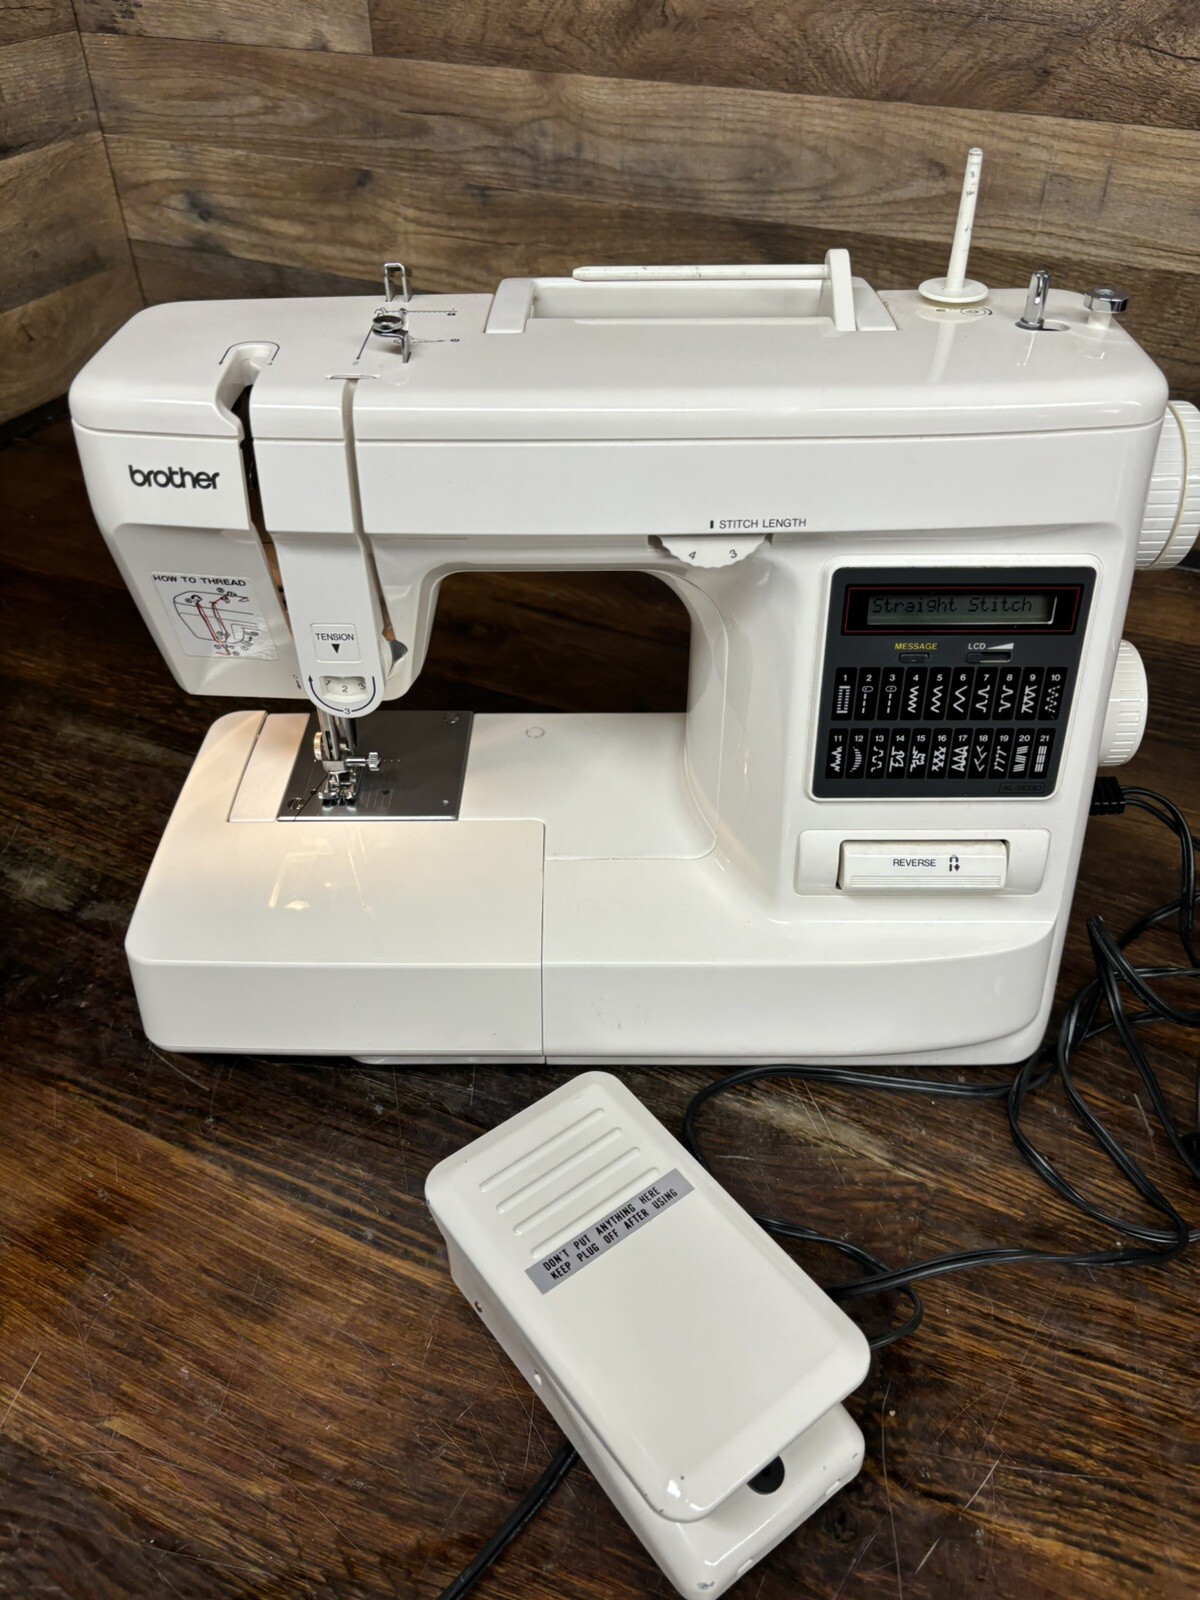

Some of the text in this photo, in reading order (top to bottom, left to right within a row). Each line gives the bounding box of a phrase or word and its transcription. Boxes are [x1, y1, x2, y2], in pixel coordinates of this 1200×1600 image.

[128, 465, 220, 489] brother
[719, 518, 807, 529] STITCH LENGTH
[688, 550, 738, 559] 4 3
[153, 574, 246, 587] HOW TO THREAD
[872, 596, 1032, 613] Straight Stitch
[315, 633, 354, 641] TENSION
[968, 642, 986, 650] LCD
[892, 858, 936, 867] REVERSE
[543, 1186, 661, 1271] DON'T PUT ANYTHING HERE
[550, 1188, 678, 1280] KEEP PLUG OFF AFTER USING
